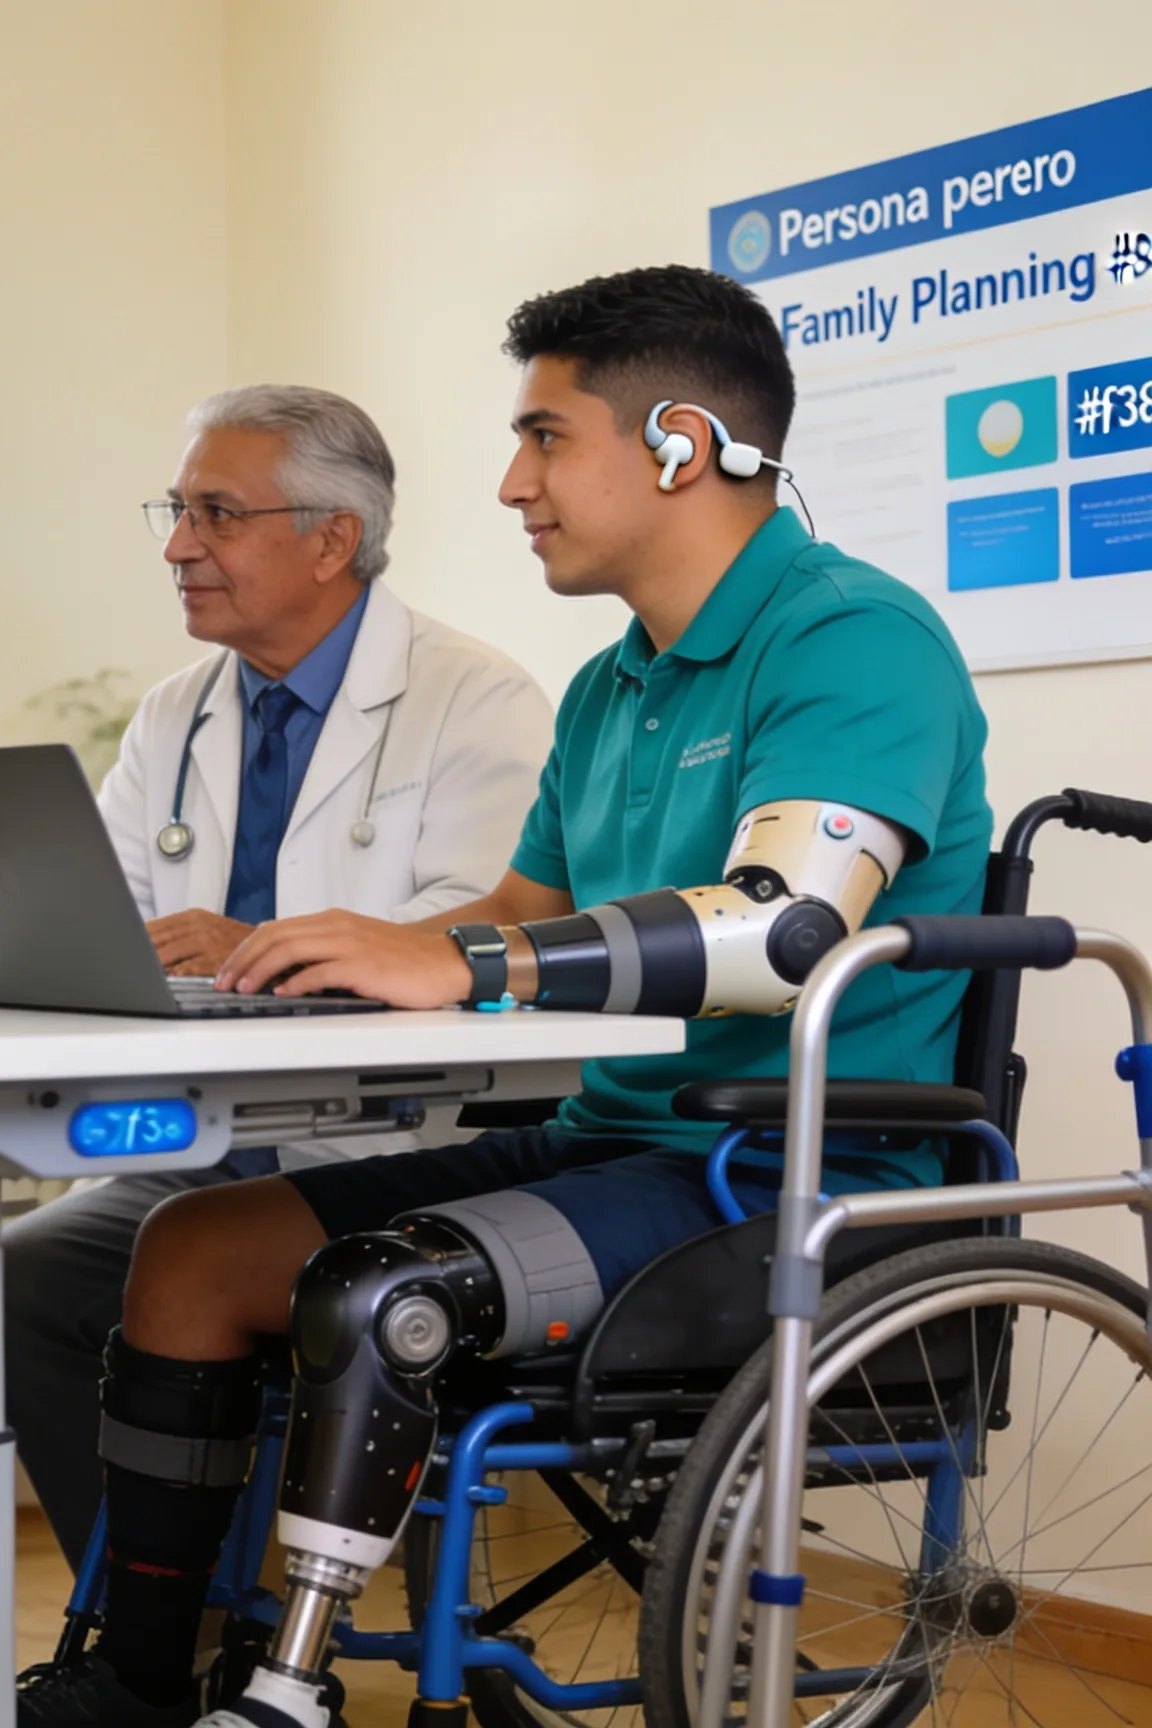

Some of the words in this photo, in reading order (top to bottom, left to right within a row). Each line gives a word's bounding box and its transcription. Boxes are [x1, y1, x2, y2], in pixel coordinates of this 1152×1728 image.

[779, 186, 929, 257] Persona
[943, 149, 1077, 229] perero
[780, 285, 899, 352] Family
[912, 252, 1097, 324] Planning
